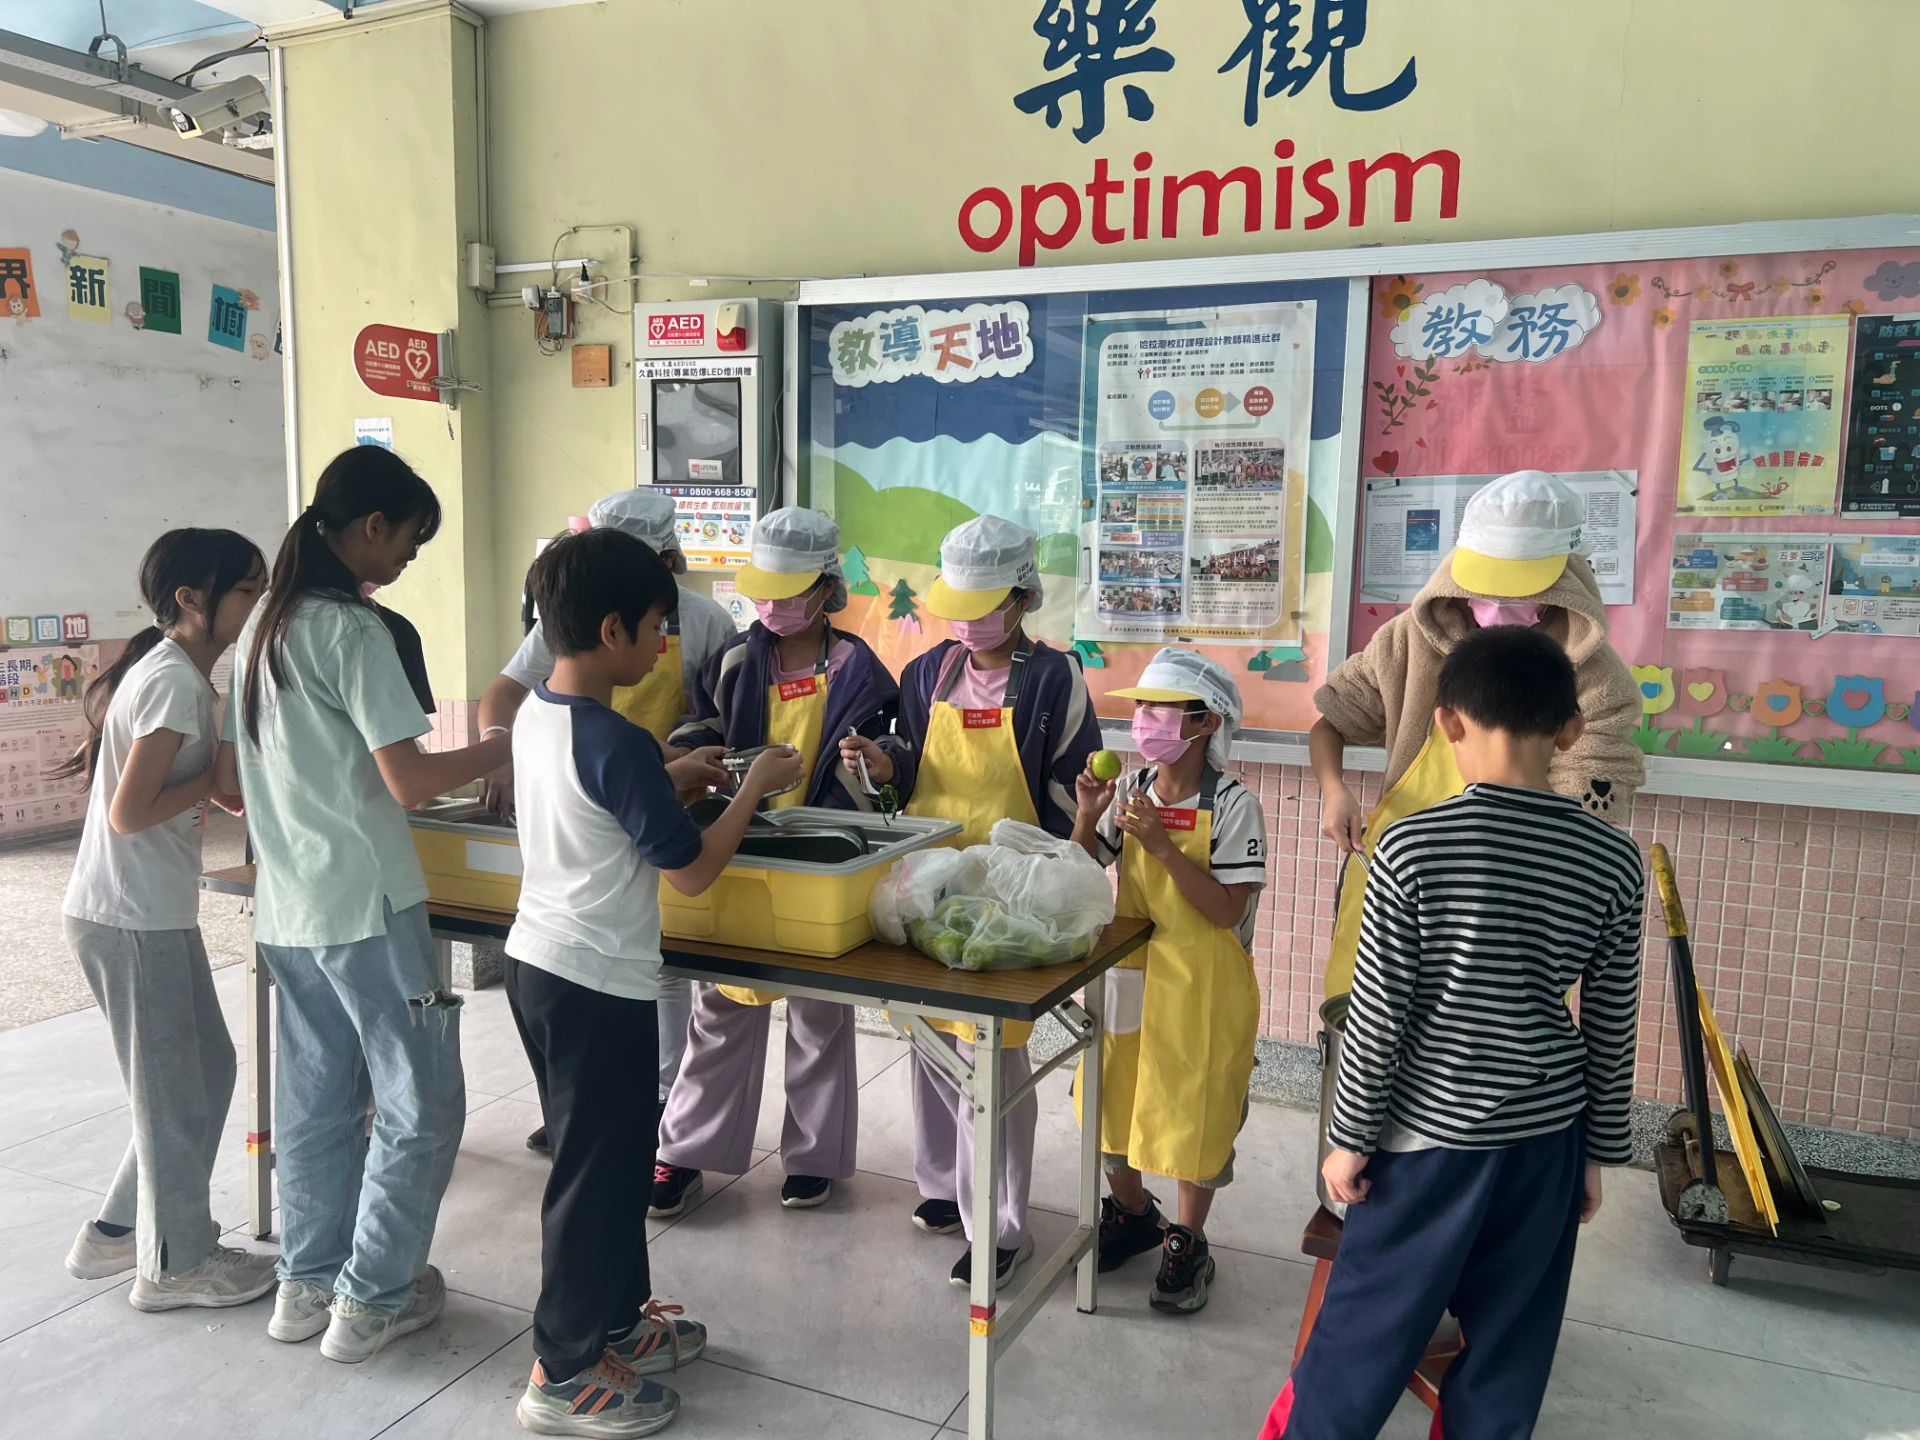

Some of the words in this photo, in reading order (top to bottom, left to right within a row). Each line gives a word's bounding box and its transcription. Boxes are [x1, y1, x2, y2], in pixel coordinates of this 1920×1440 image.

[1013, 0, 1416, 141] 樂觀
[957, 138, 1462, 267] optimism
[667, 316, 701, 330] AED
[1421, 302, 1577, 357] 教務
[365, 339, 400, 359] AED
[407, 338, 428, 350] AED
[837, 311, 1023, 375] 教導天地
[689, 487, 751, 497] 0800-668-850
